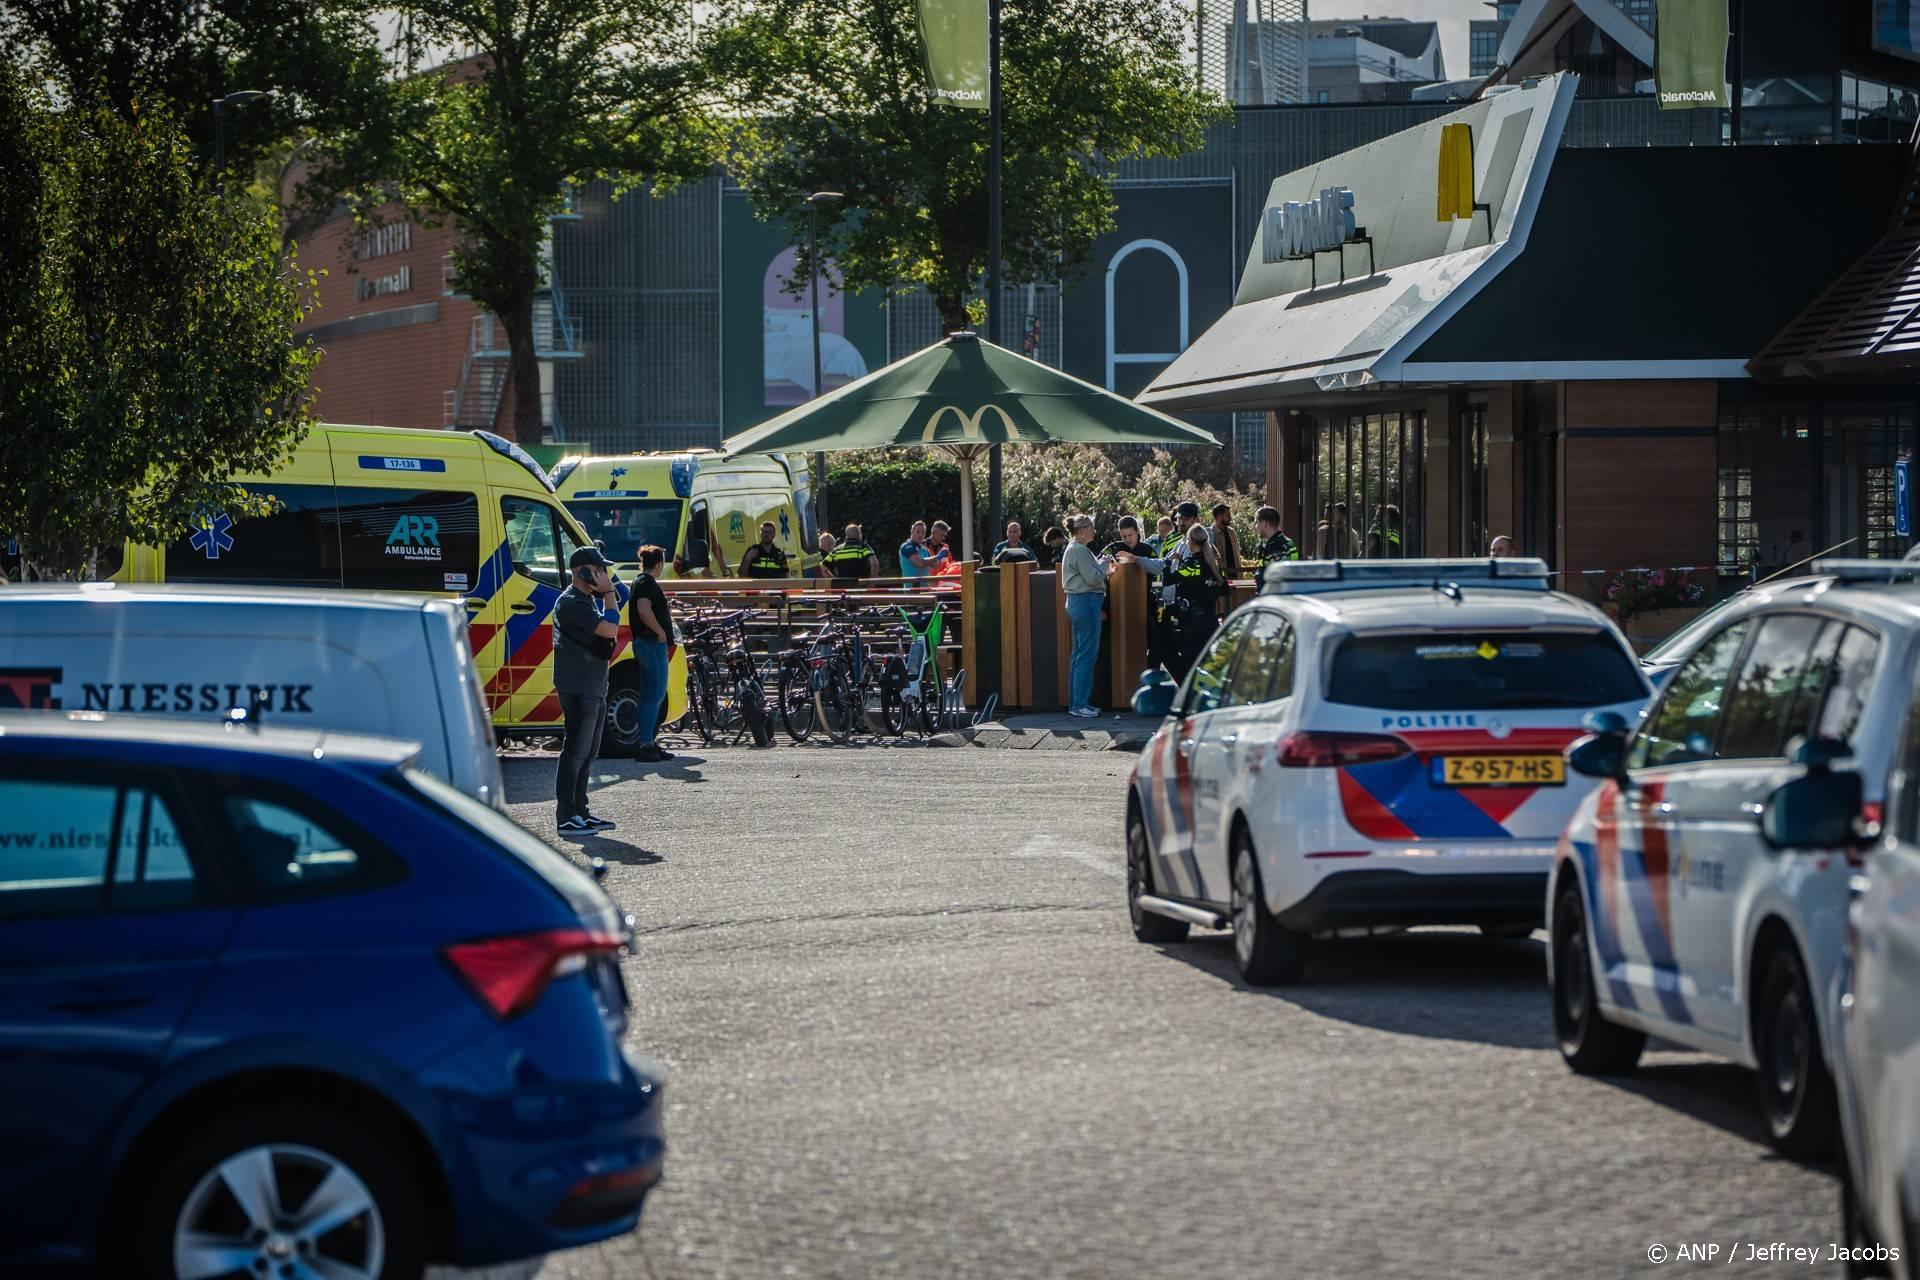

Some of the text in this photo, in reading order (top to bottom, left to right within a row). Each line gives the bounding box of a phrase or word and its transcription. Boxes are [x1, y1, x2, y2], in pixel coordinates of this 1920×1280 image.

[390, 460, 415, 468] 17-136
[1898, 469, 1905, 504] P
[385, 514, 440, 546] ARR
[384, 545, 441, 555] AMBULANCE
[81, 683, 313, 713] NIESSINK
[1381, 715, 1477, 729] POLITIE
[1451, 759, 1554, 780] Z-957-HS
